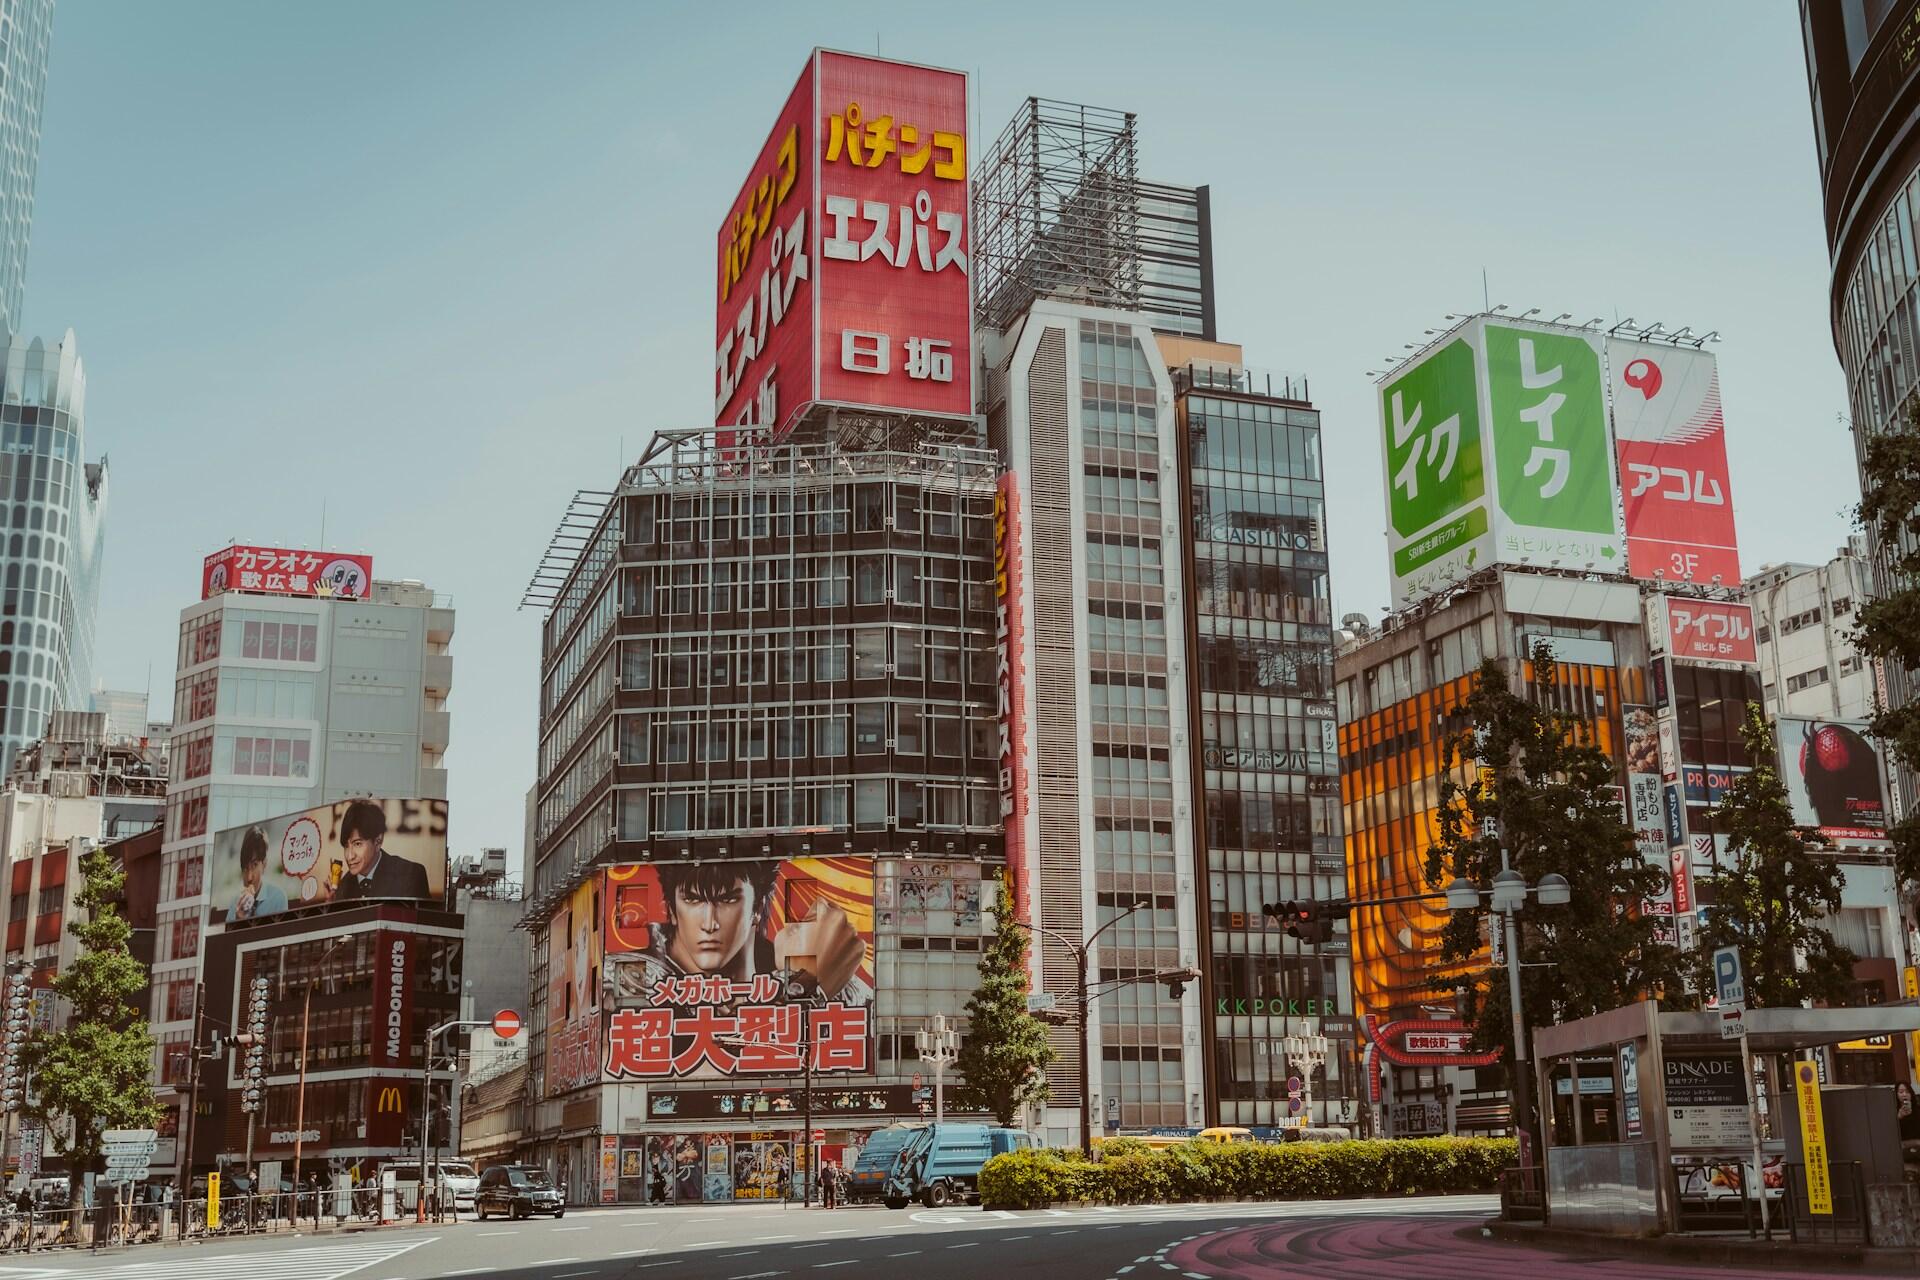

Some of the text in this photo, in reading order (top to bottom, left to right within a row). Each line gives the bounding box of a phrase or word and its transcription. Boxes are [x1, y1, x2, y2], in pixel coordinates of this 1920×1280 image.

[825, 102, 965, 181] パチンコ
[722, 122, 799, 303] パチンコ
[823, 189, 967, 276] エスパス
[716, 208, 808, 416] エスパス
[841, 329, 953, 382] 日拓
[1517, 338, 1571, 498] レイク
[1391, 389, 1460, 501] レイク
[1628, 463, 1724, 505] アコム
[1213, 527, 1308, 550] CASINO
[1408, 520, 1467, 561] SBI新生銀行グループ
[1506, 535, 1595, 558] 当ビルとなり
[235, 549, 323, 573] カラオケ
[1407, 556, 1464, 596] 当ビルとなり
[1671, 553, 1698, 575] 3F
[240, 571, 309, 591] 歌広場
[245, 633, 316, 651] カラオケ
[1671, 609, 1750, 640] アイフル
[1694, 642, 1733, 653] 当ビル 5F
[1325, 723, 1333, 750] ダーツ
[1634, 783, 1648, 822] 専門店
[1646, 777, 1659, 816] 粉もの
[1669, 792, 1680, 841] セントラル
[1635, 828, 1665, 844] 本陣
[1676, 873, 1688, 903] アコム
[1644, 904, 1673, 914] たばこ
[651, 974, 782, 1005] メガホール
[1717, 952, 1737, 1000] P
[387, 940, 405, 1058] McDonald's
[1218, 1000, 1336, 1016] KKPOKER
[606, 1002, 869, 1077] 超大型店
[1622, 1054, 1630, 1088] P
[1109, 1099, 1116, 1109] P
[1803, 1086, 1818, 1143] 違法駐車禁止
[270, 1131, 320, 1143] McDonald's
